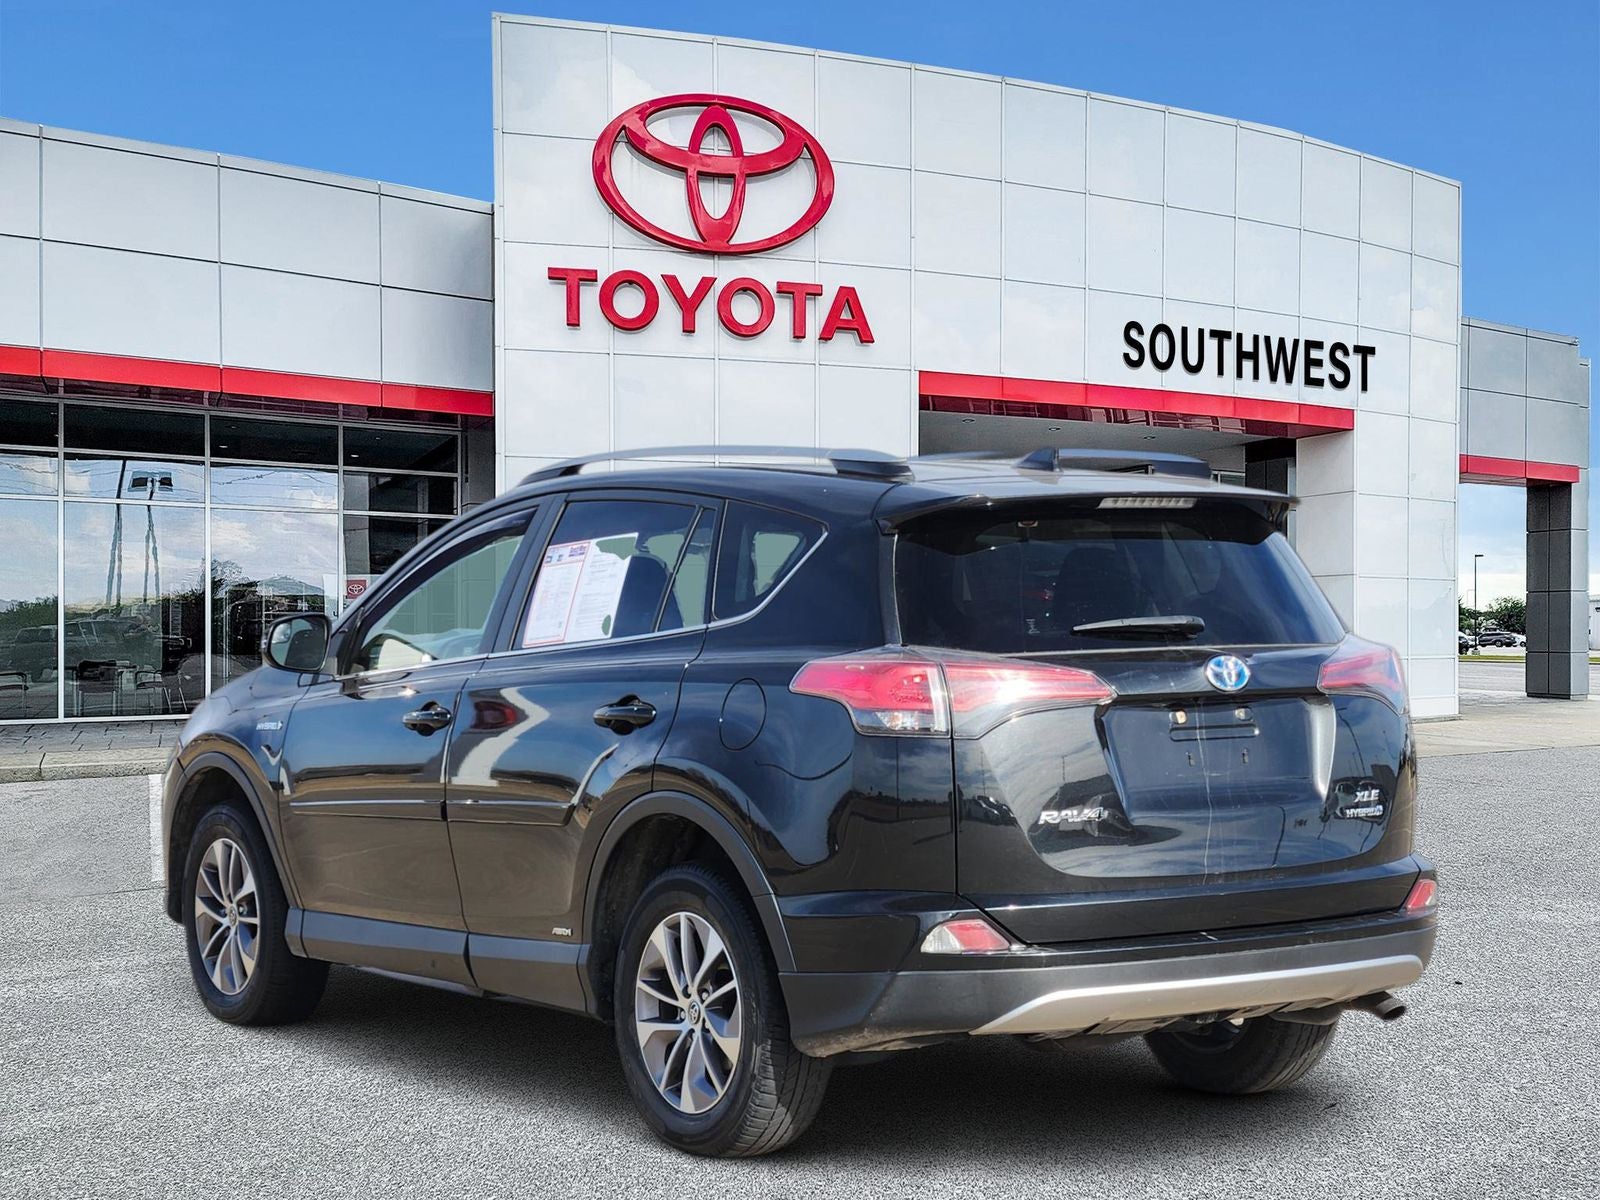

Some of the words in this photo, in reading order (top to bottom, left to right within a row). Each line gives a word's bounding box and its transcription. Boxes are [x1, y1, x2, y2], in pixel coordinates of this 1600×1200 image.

[548, 267, 875, 344] TOYOTA
[1123, 320, 1376, 391] SOUTHWEST
[1354, 789, 1380, 802] XLE
[1039, 807, 1108, 824] RAV4
[1346, 807, 1378, 817] HYBRID
